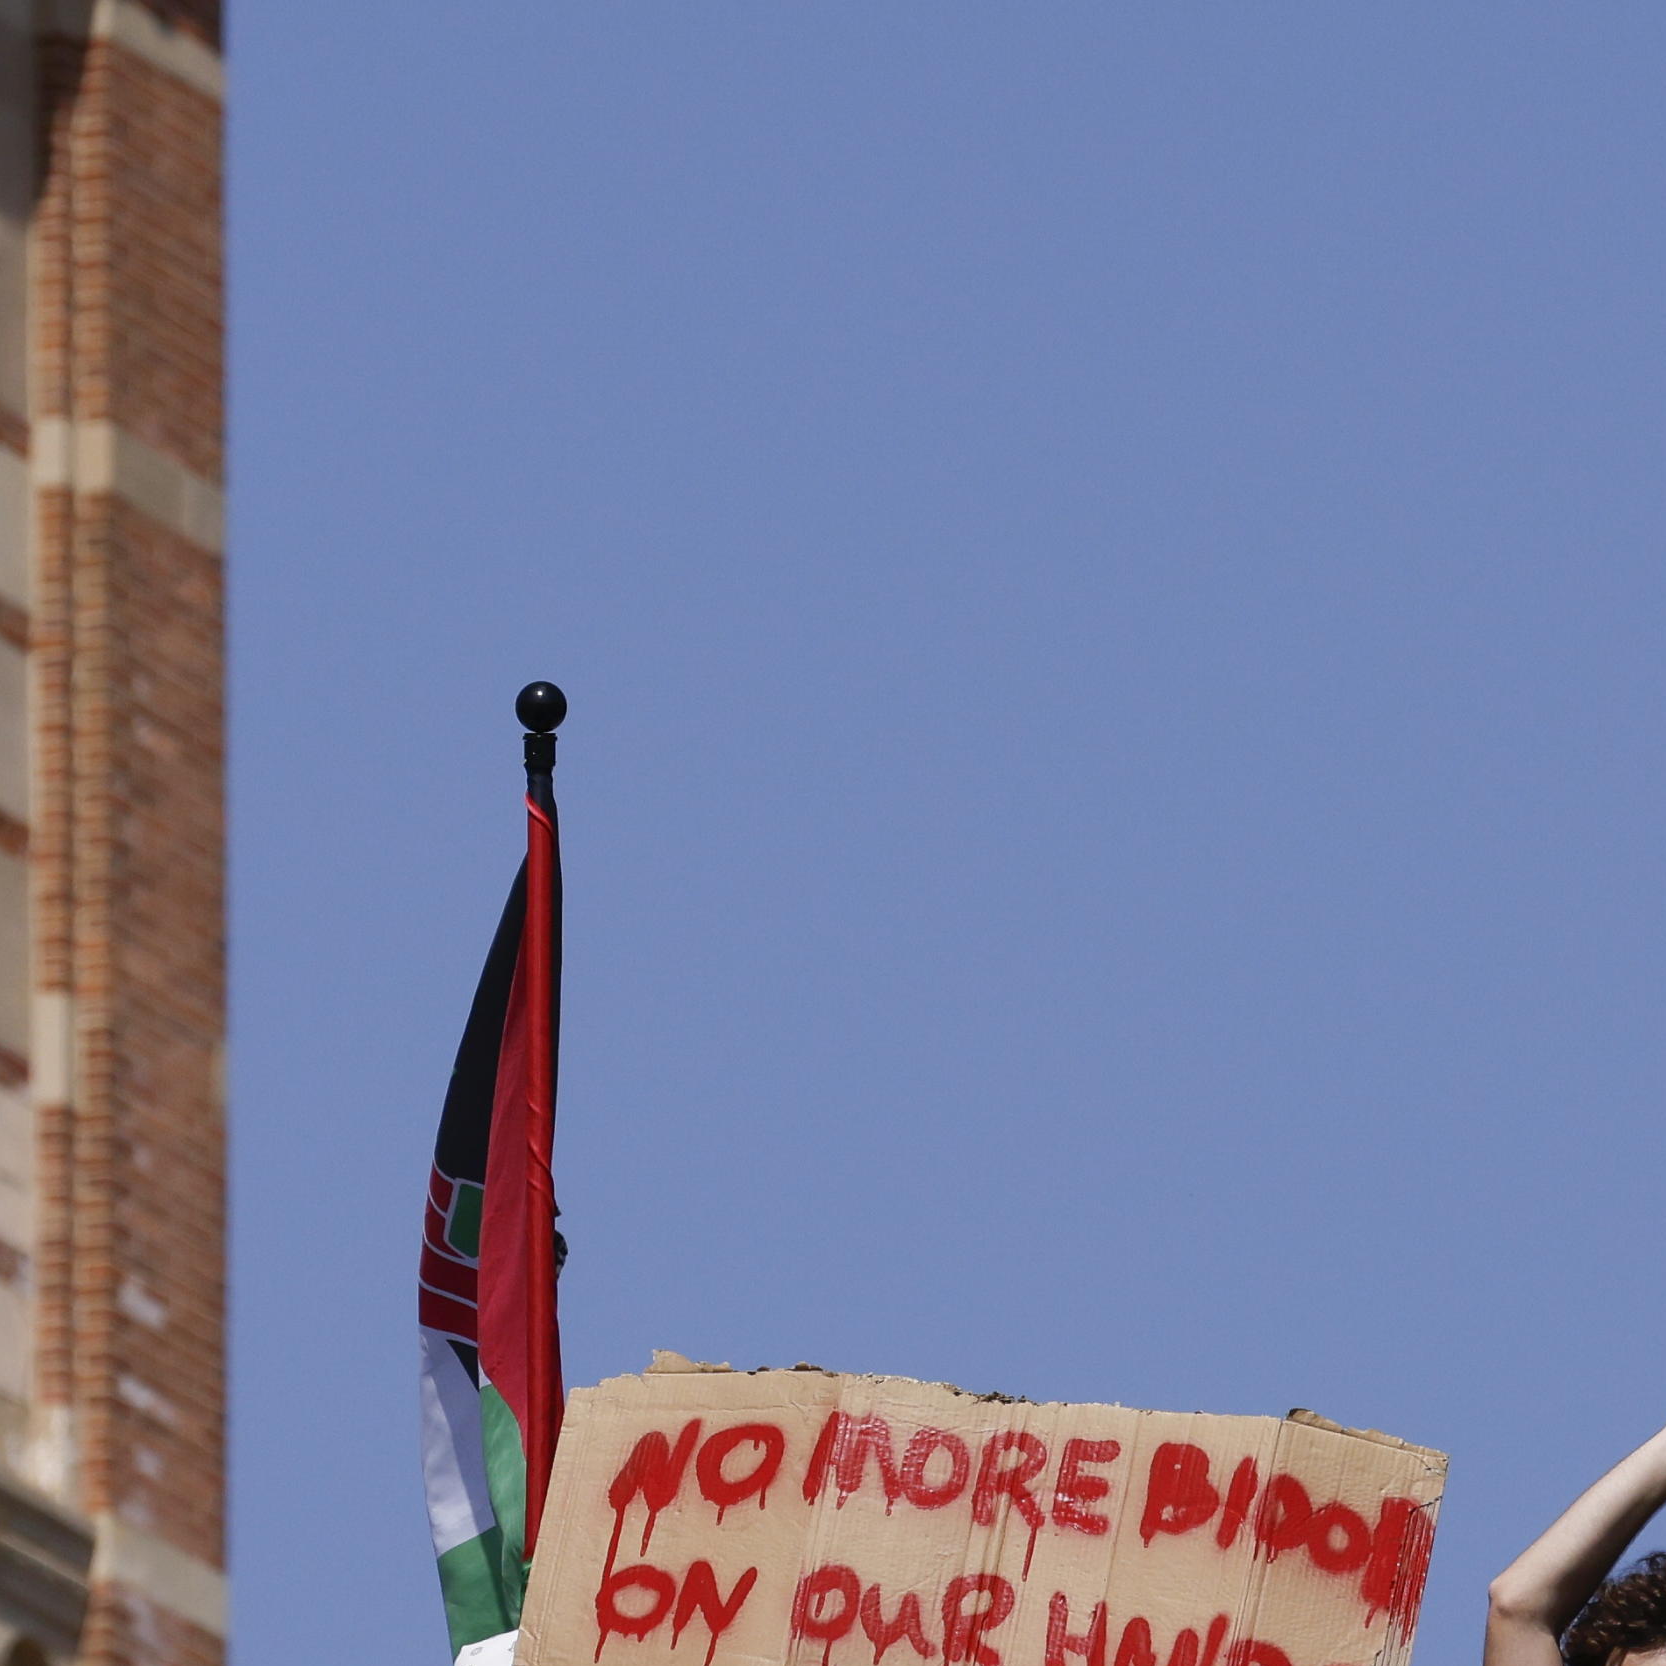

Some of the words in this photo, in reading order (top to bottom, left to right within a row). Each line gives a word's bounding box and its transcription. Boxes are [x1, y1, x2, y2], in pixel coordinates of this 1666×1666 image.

[608, 1417, 785, 1552] NO
[802, 1410, 1121, 1550] MORE
[596, 1560, 757, 1660] ON
